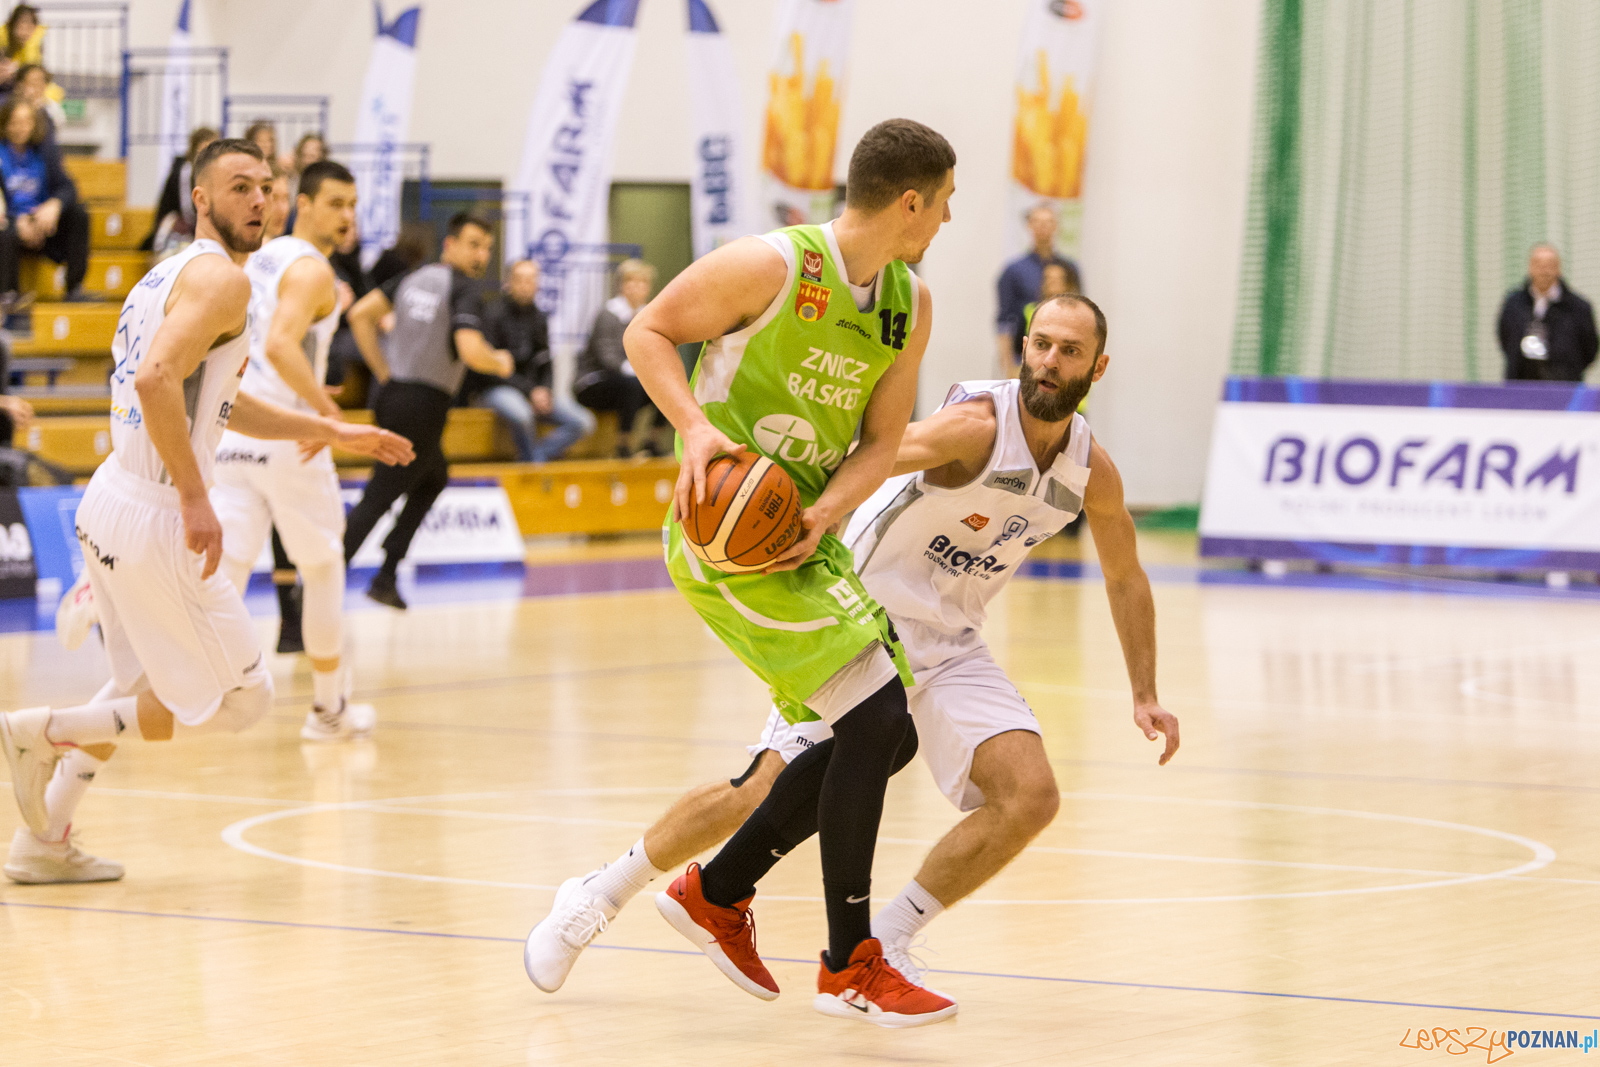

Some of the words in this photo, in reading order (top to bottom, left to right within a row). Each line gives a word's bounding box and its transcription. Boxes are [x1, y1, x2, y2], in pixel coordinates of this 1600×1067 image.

[879, 308, 908, 350] 14
[800, 346, 870, 383] ZNICZ
[1262, 434, 1582, 495] BIOFARM
[763, 492, 785, 521] FIBA
